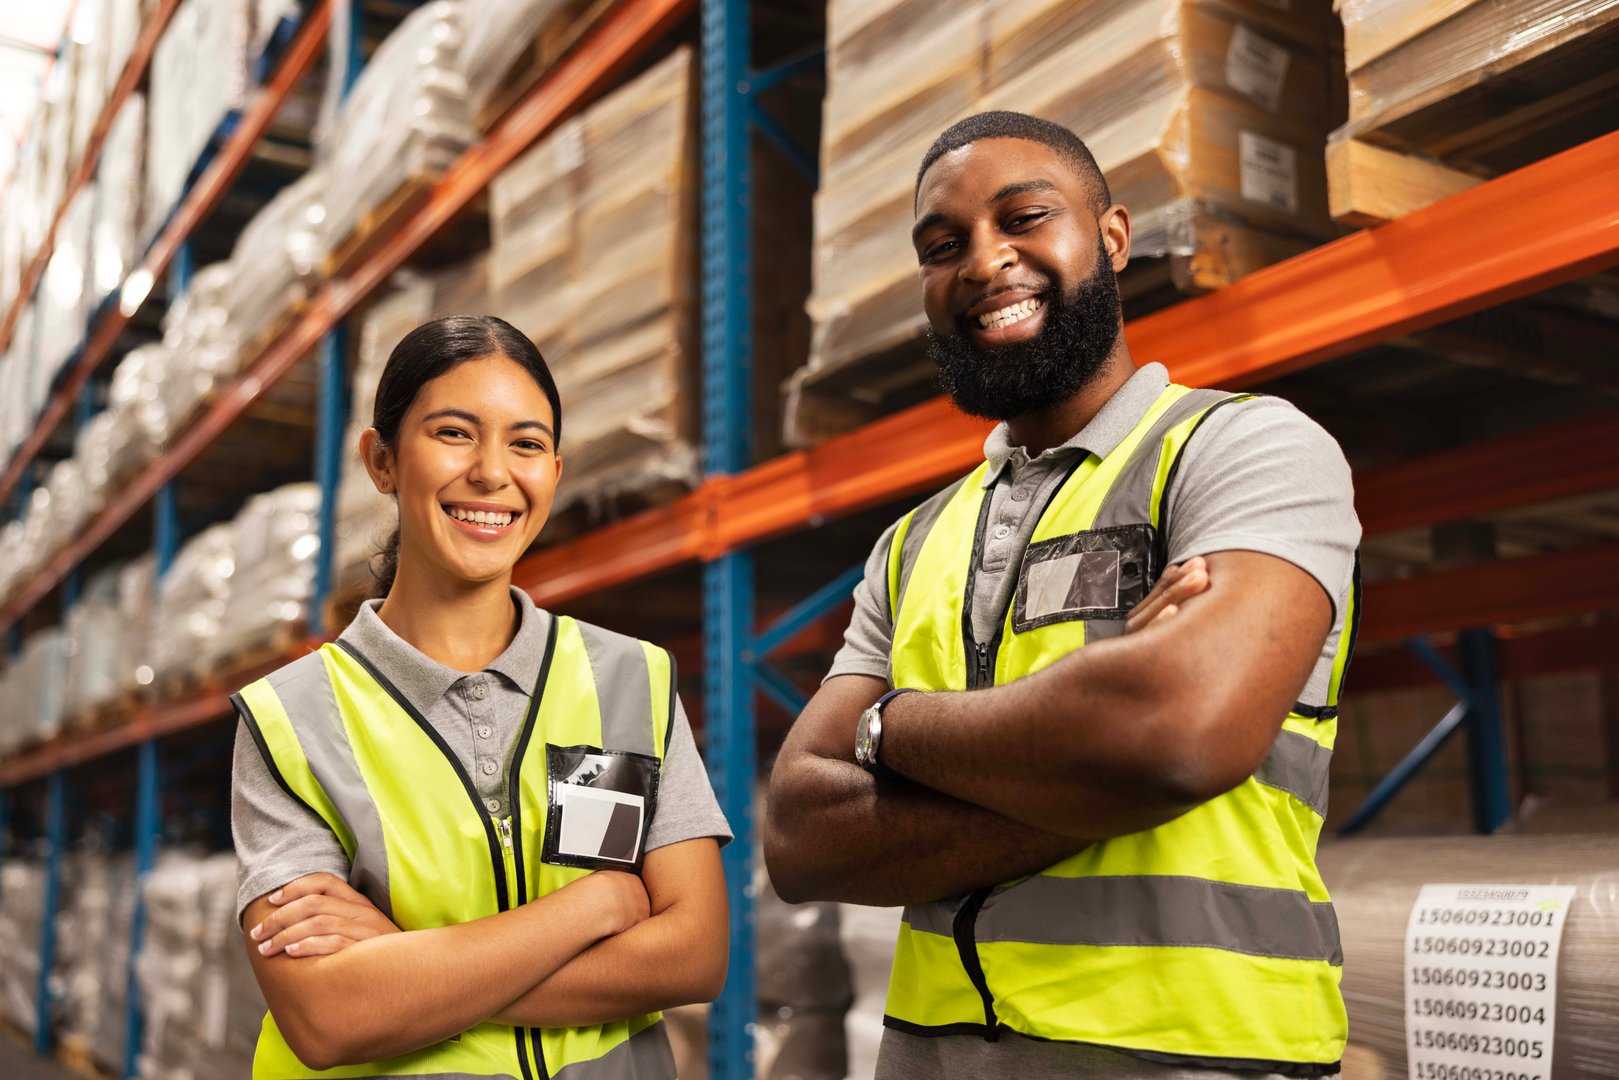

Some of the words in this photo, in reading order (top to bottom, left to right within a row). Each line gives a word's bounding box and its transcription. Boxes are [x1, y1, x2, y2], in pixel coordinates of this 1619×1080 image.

[1418, 909, 1554, 927] 15060923001
[1412, 936, 1550, 959] 15060923002
[1411, 966, 1547, 992] 15060923003
[1412, 998, 1546, 1026] 15060923004
[1413, 1029, 1544, 1060] 15060923005
